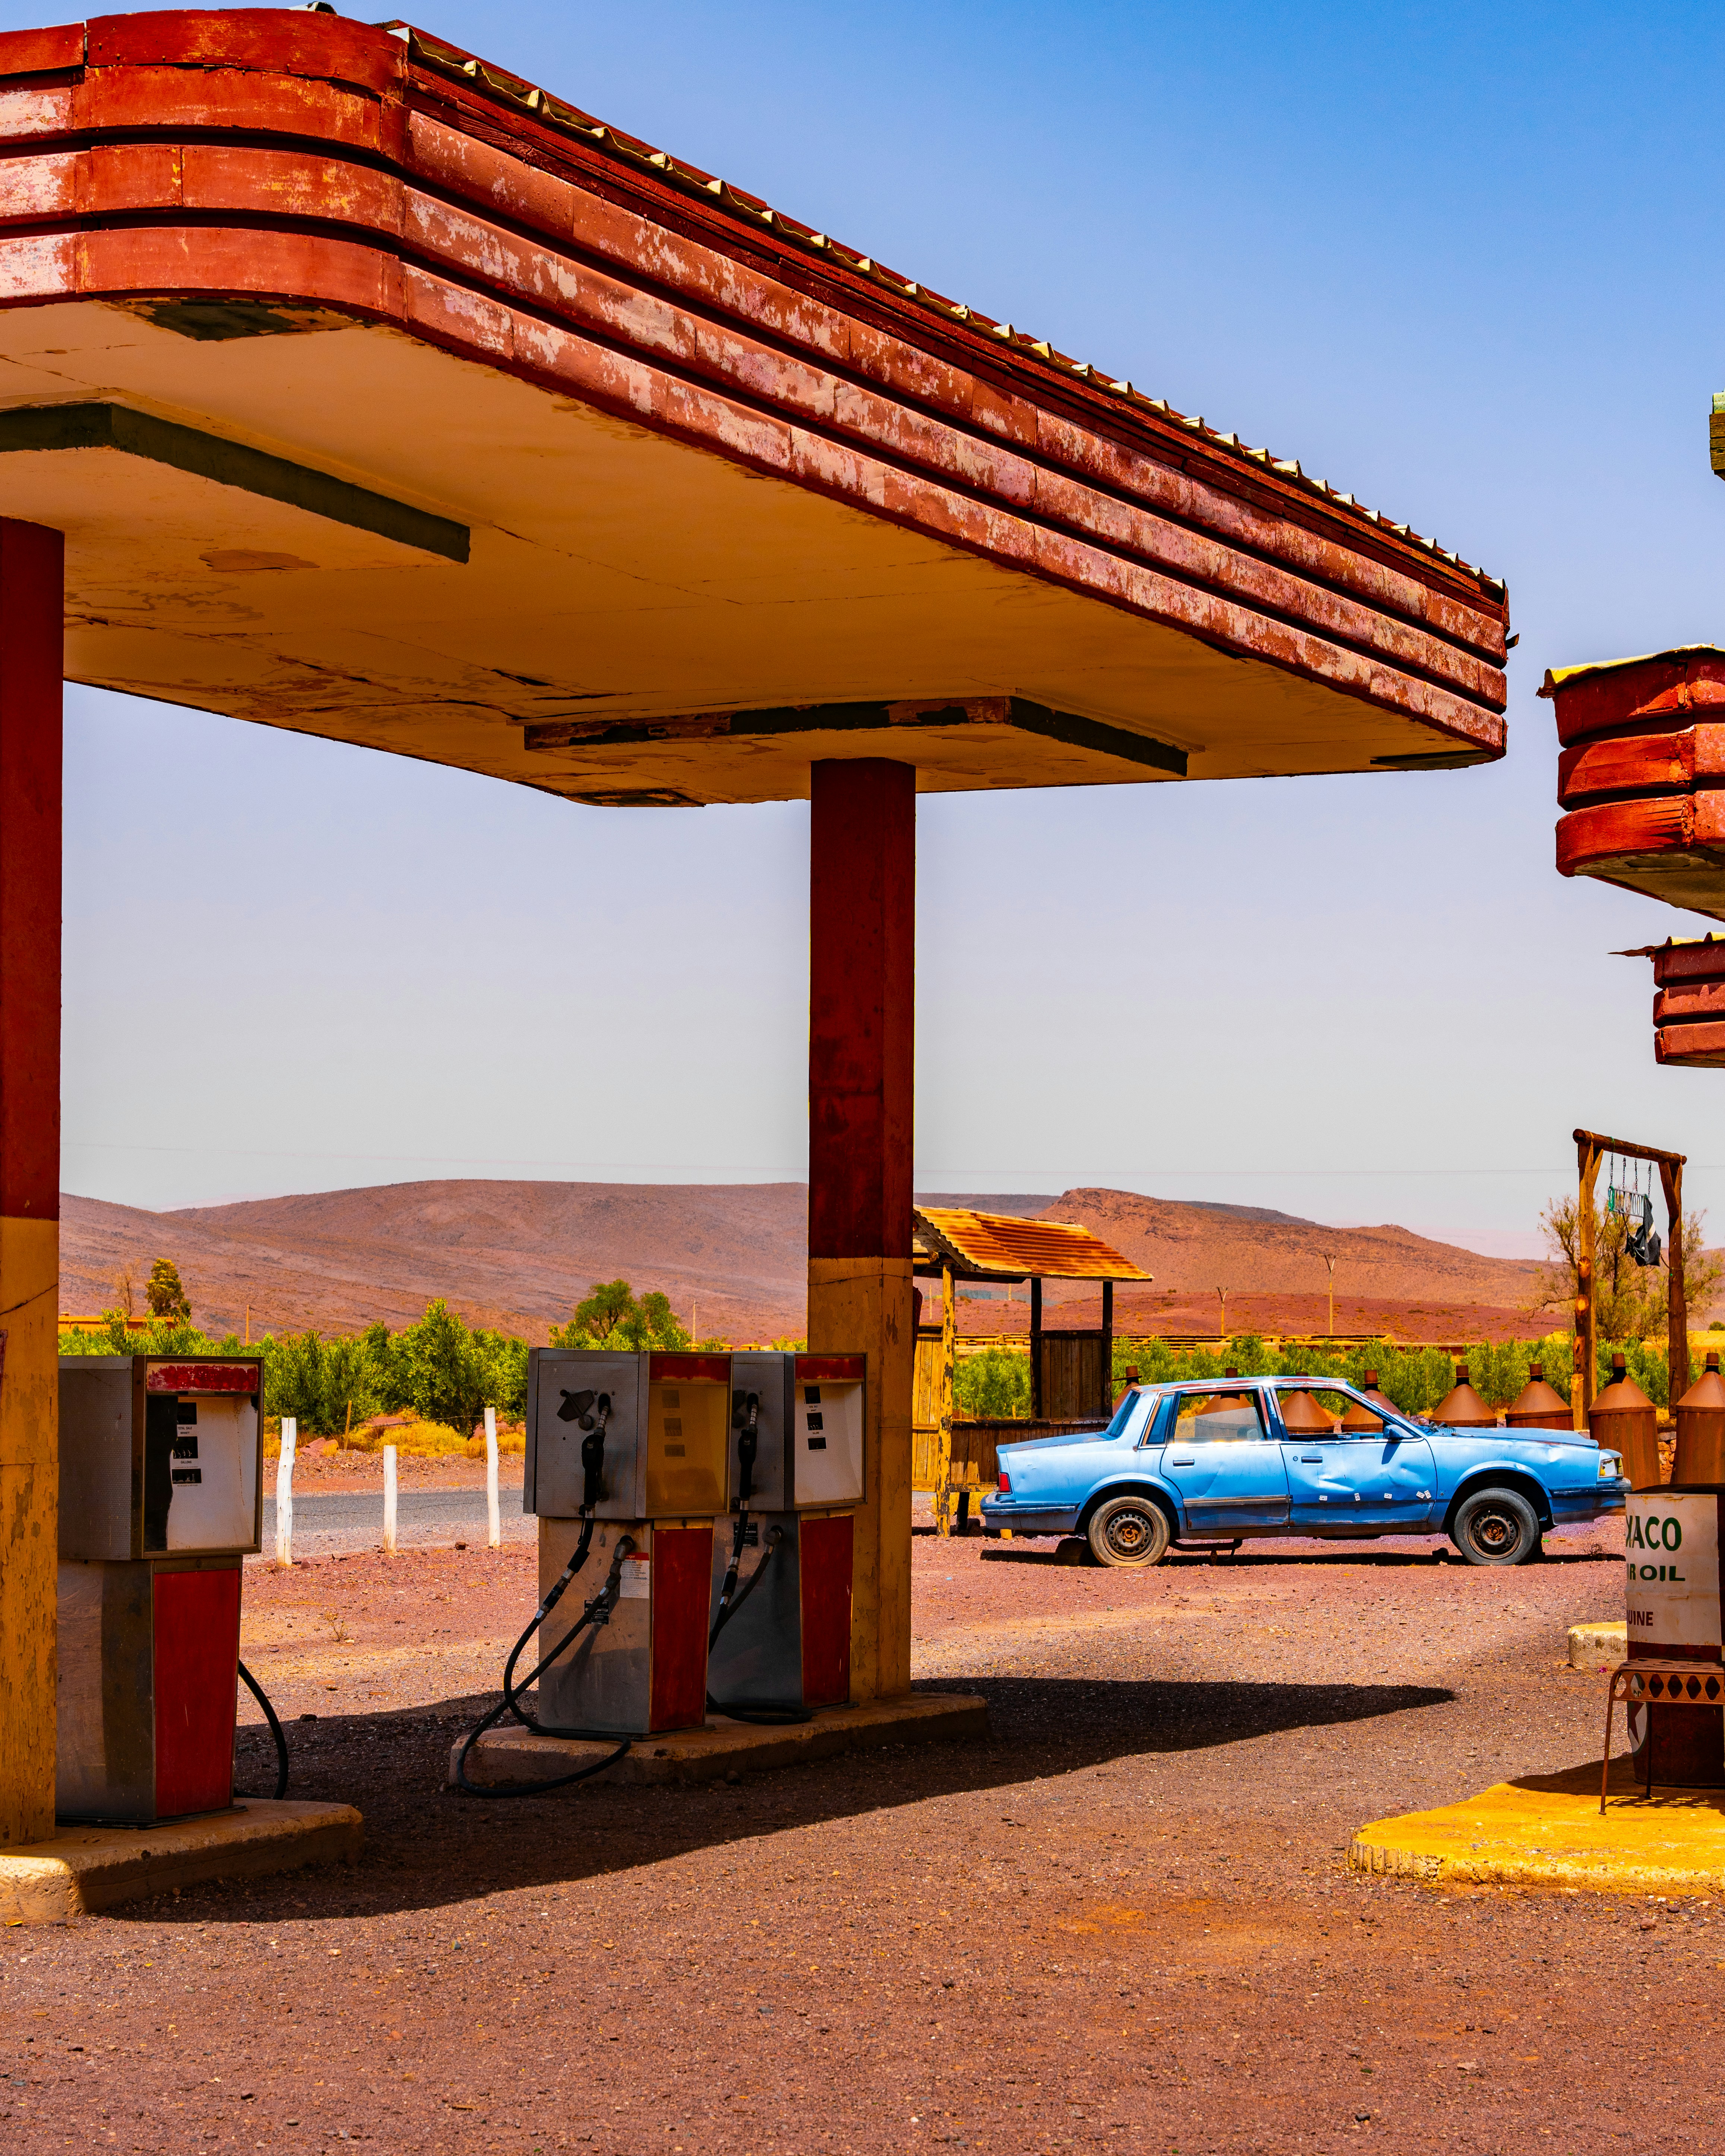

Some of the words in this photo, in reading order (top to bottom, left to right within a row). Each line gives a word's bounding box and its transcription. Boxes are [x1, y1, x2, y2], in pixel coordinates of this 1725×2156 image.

[1626, 1515, 1682, 1551] XACO
[1640, 1565, 1686, 1581] OIL
[1627, 1610, 1653, 1626] UINE
